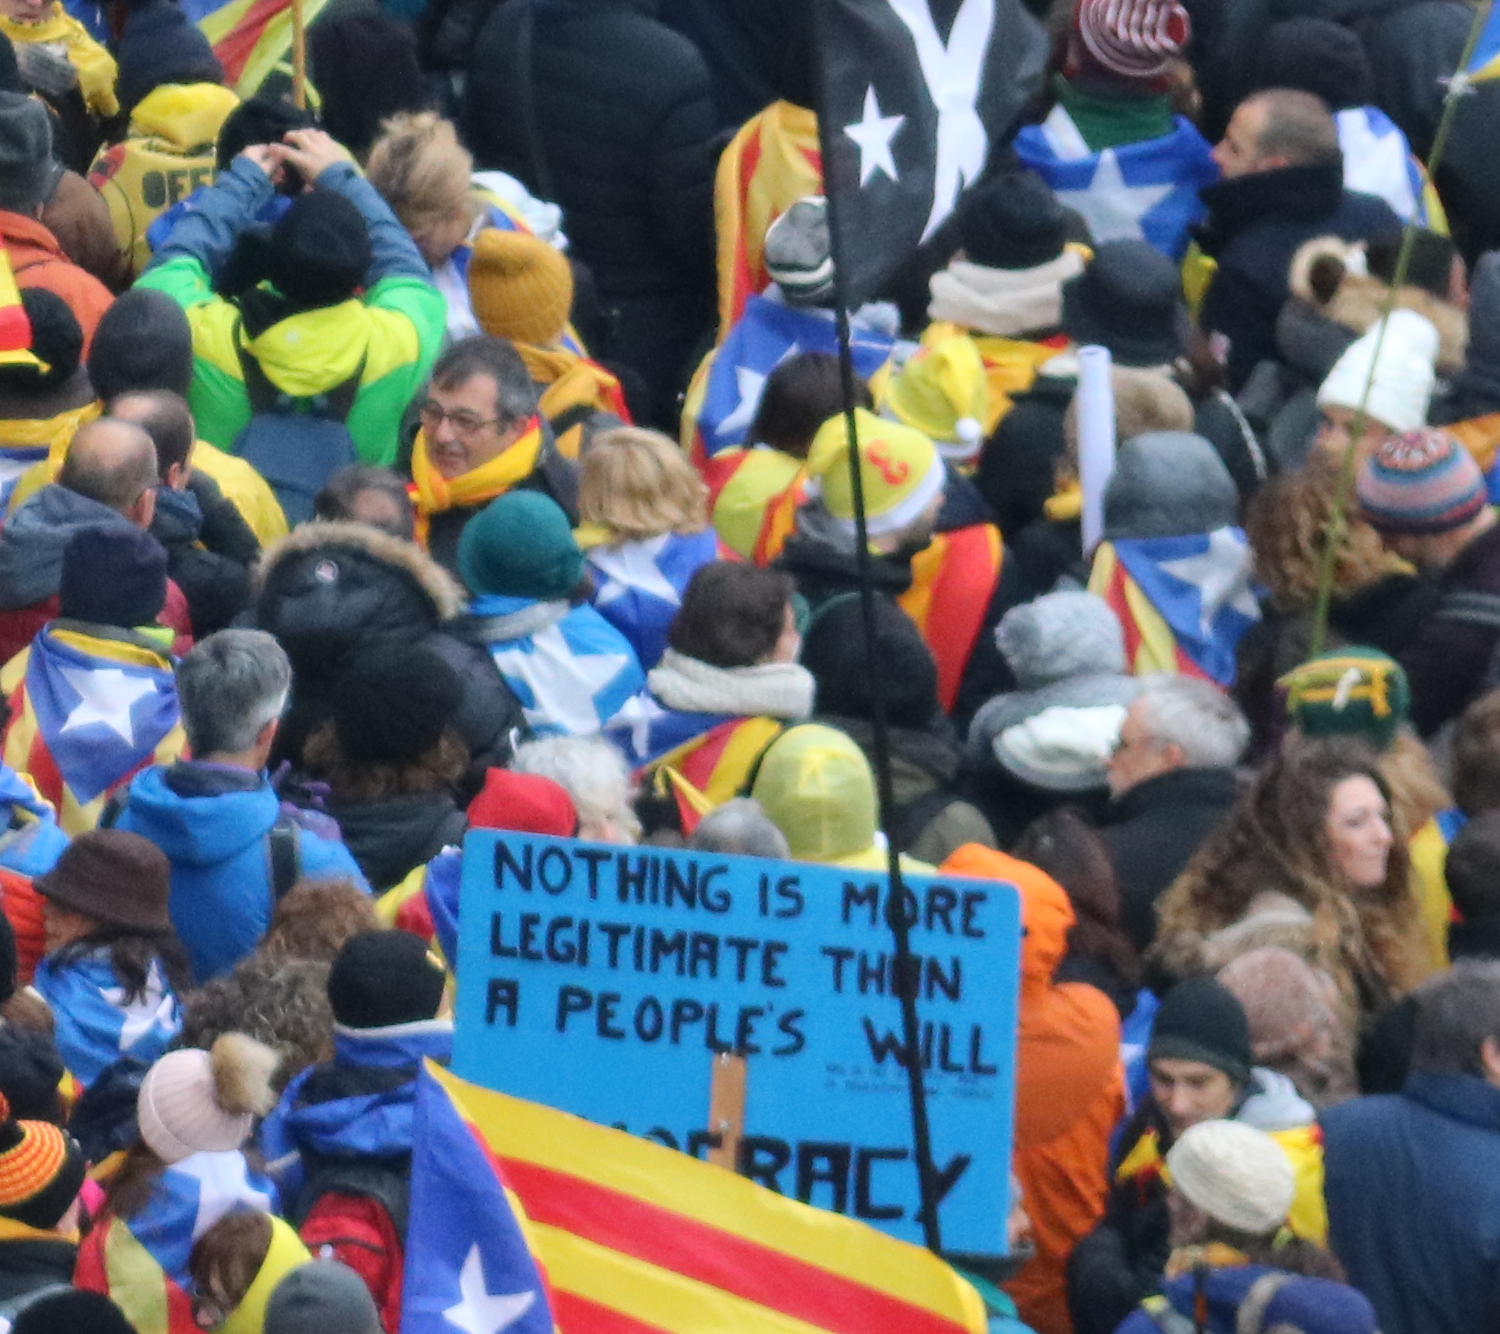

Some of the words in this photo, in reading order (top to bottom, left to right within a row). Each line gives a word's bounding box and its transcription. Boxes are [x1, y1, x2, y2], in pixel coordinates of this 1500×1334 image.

[493, 840, 732, 914] NOTHING
[759, 873, 804, 919] IS
[841, 881, 988, 939] MORE
[489, 911, 790, 989] LEGITIMATE
[485, 977, 519, 1026] A
[555, 985, 806, 1056] PEOPLE'S
[862, 1016, 998, 1076] WILL
